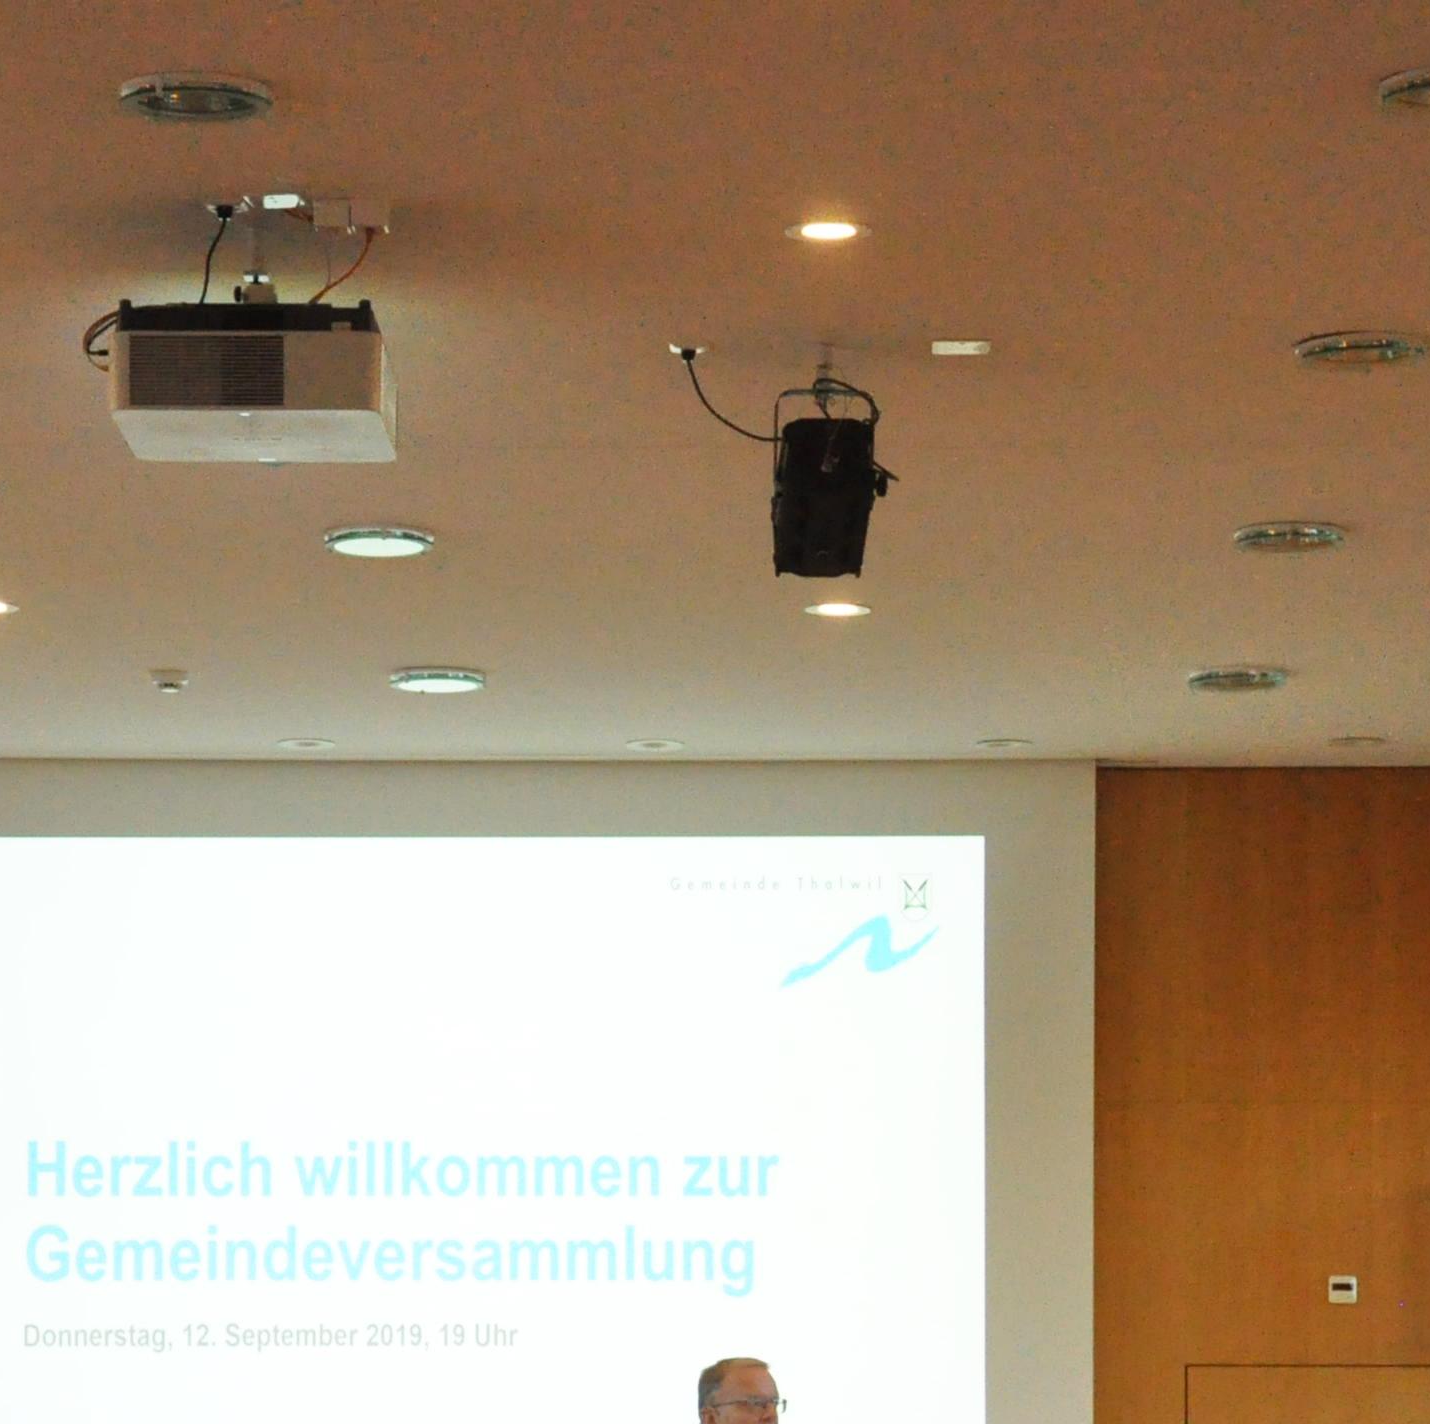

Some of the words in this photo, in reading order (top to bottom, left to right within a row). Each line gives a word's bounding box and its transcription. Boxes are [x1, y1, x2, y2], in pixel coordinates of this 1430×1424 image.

[669, 876, 781, 891] Gemeinde
[797, 876, 884, 891] Thalwil
[27, 1139, 272, 1198] Herzlich
[294, 1139, 660, 1198] willkommen
[682, 1155, 780, 1198] zur
[26, 1224, 755, 1298] Gemeindeversammlung
[23, 1323, 173, 1352] Donnerstag,
[183, 1323, 215, 1347] 12.
[225, 1323, 358, 1352] September
[365, 1323, 428, 1350] 2019,
[440, 1323, 465, 1346] 19
[475, 1323, 518, 1346] Uhr
